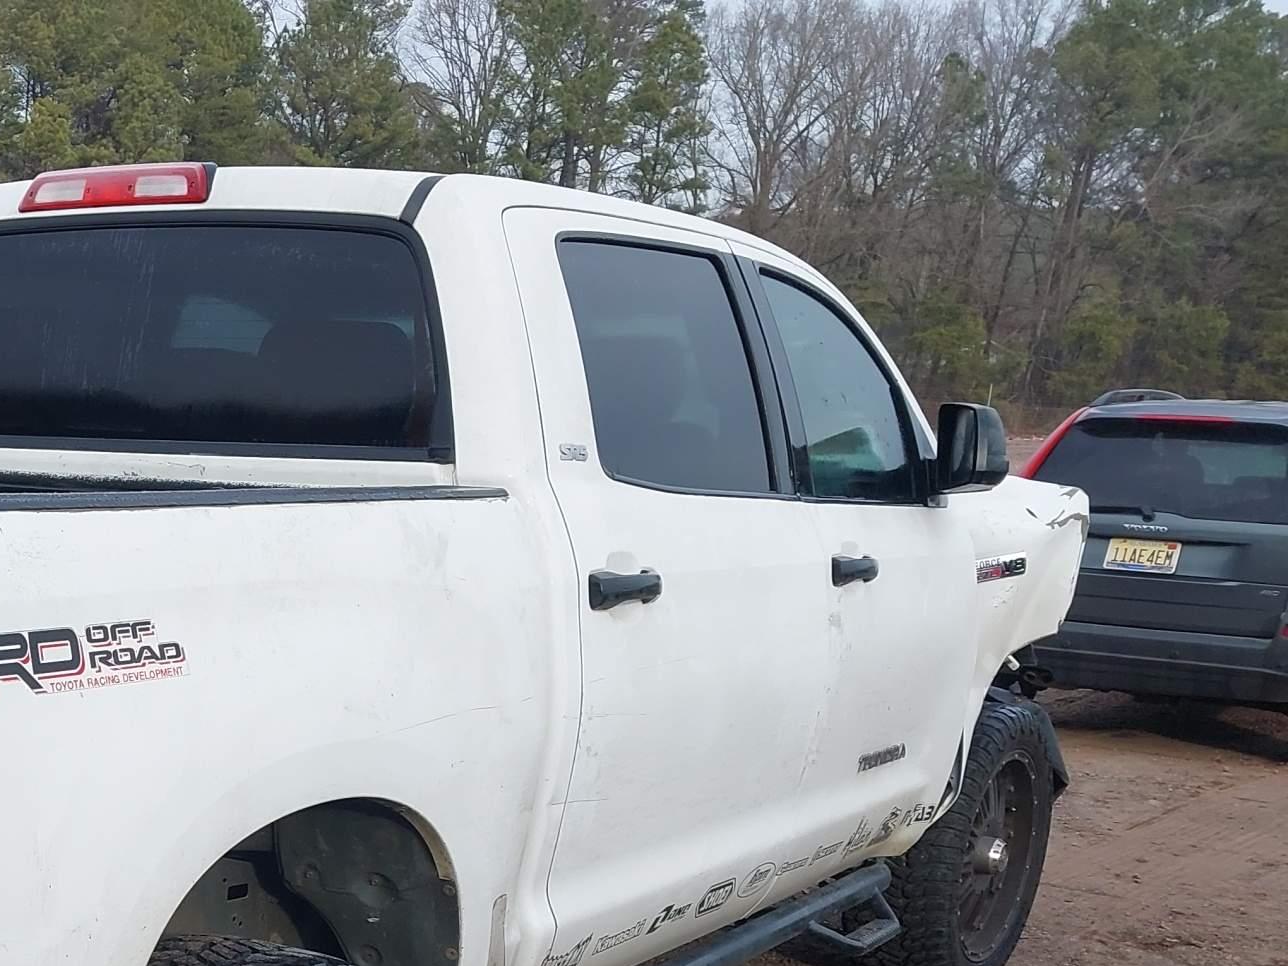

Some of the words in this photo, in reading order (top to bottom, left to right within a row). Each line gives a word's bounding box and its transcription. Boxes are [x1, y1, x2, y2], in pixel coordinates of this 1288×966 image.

[85, 620, 156, 647] OFF
[88, 642, 186, 674] ROAD
[50, 679, 85, 694] TOYOTA
[87, 673, 121, 690] RACING
[122, 665, 185, 683] DEVELOPMENT
